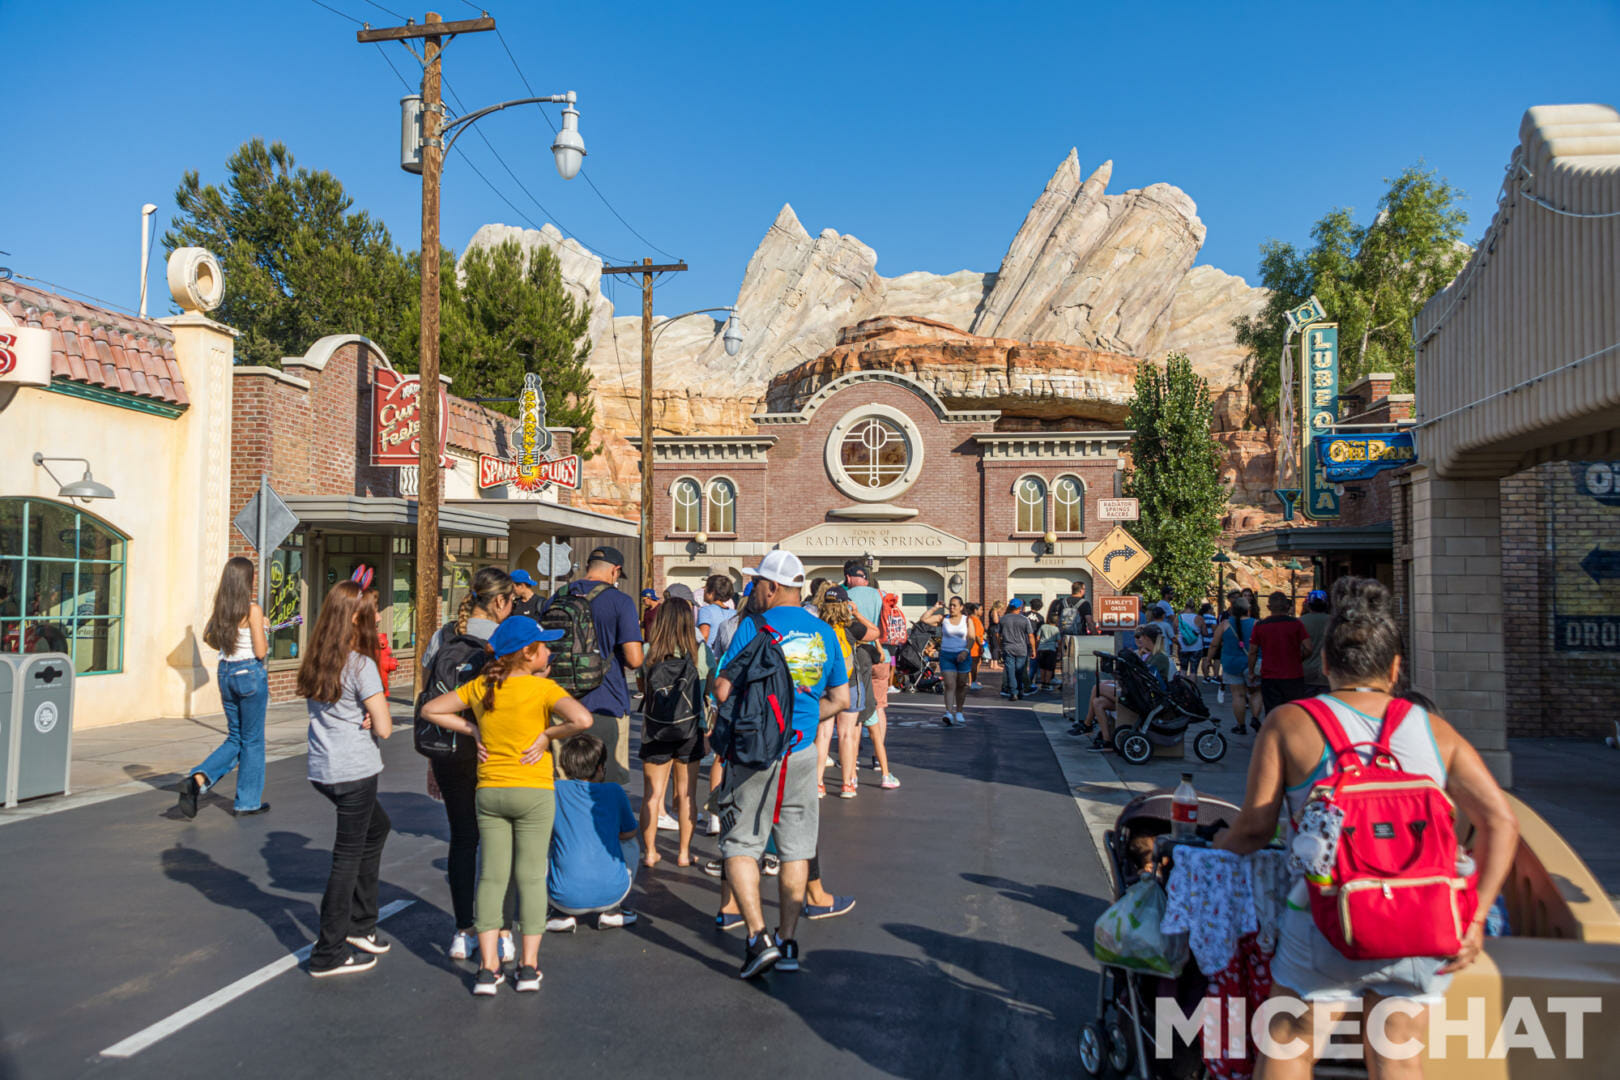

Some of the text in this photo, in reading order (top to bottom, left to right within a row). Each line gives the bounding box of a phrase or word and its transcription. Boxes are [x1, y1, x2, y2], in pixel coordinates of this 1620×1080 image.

[1313, 331, 1335, 509] LUBEOMA
[483, 458, 576, 484] SPARK PLUGS
[805, 536, 943, 547] RADIATOR SPRINGS
